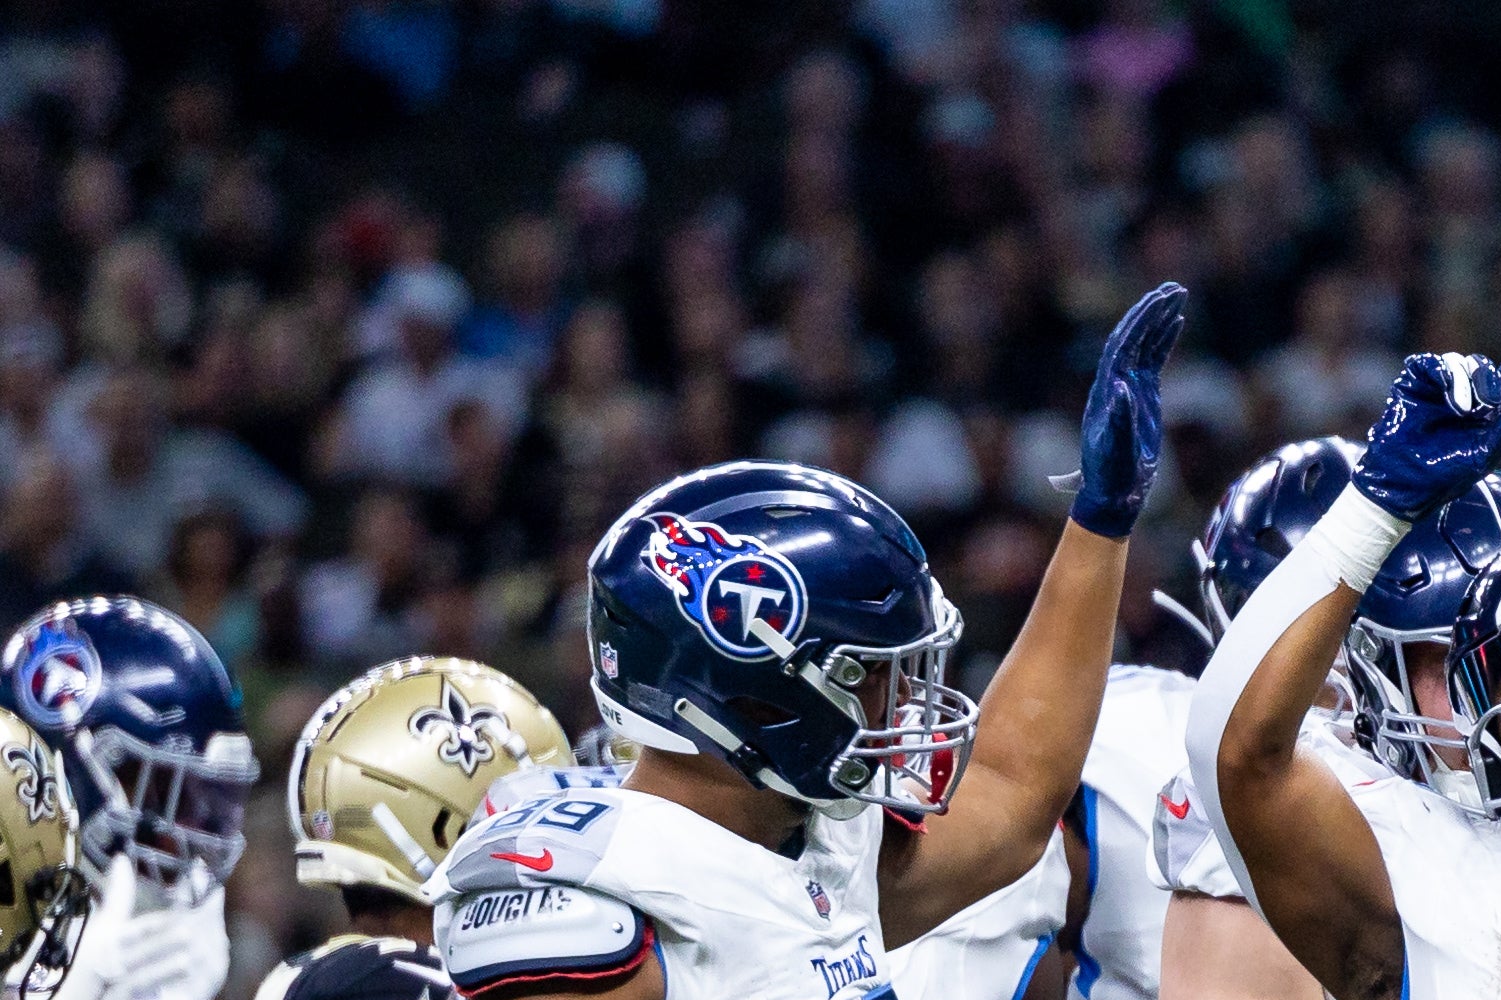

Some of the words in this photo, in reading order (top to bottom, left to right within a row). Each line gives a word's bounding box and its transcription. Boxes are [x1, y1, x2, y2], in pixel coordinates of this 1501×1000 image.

[718, 579, 788, 642] T
[477, 797, 617, 836] 89
[810, 934, 877, 1000] TITANS
